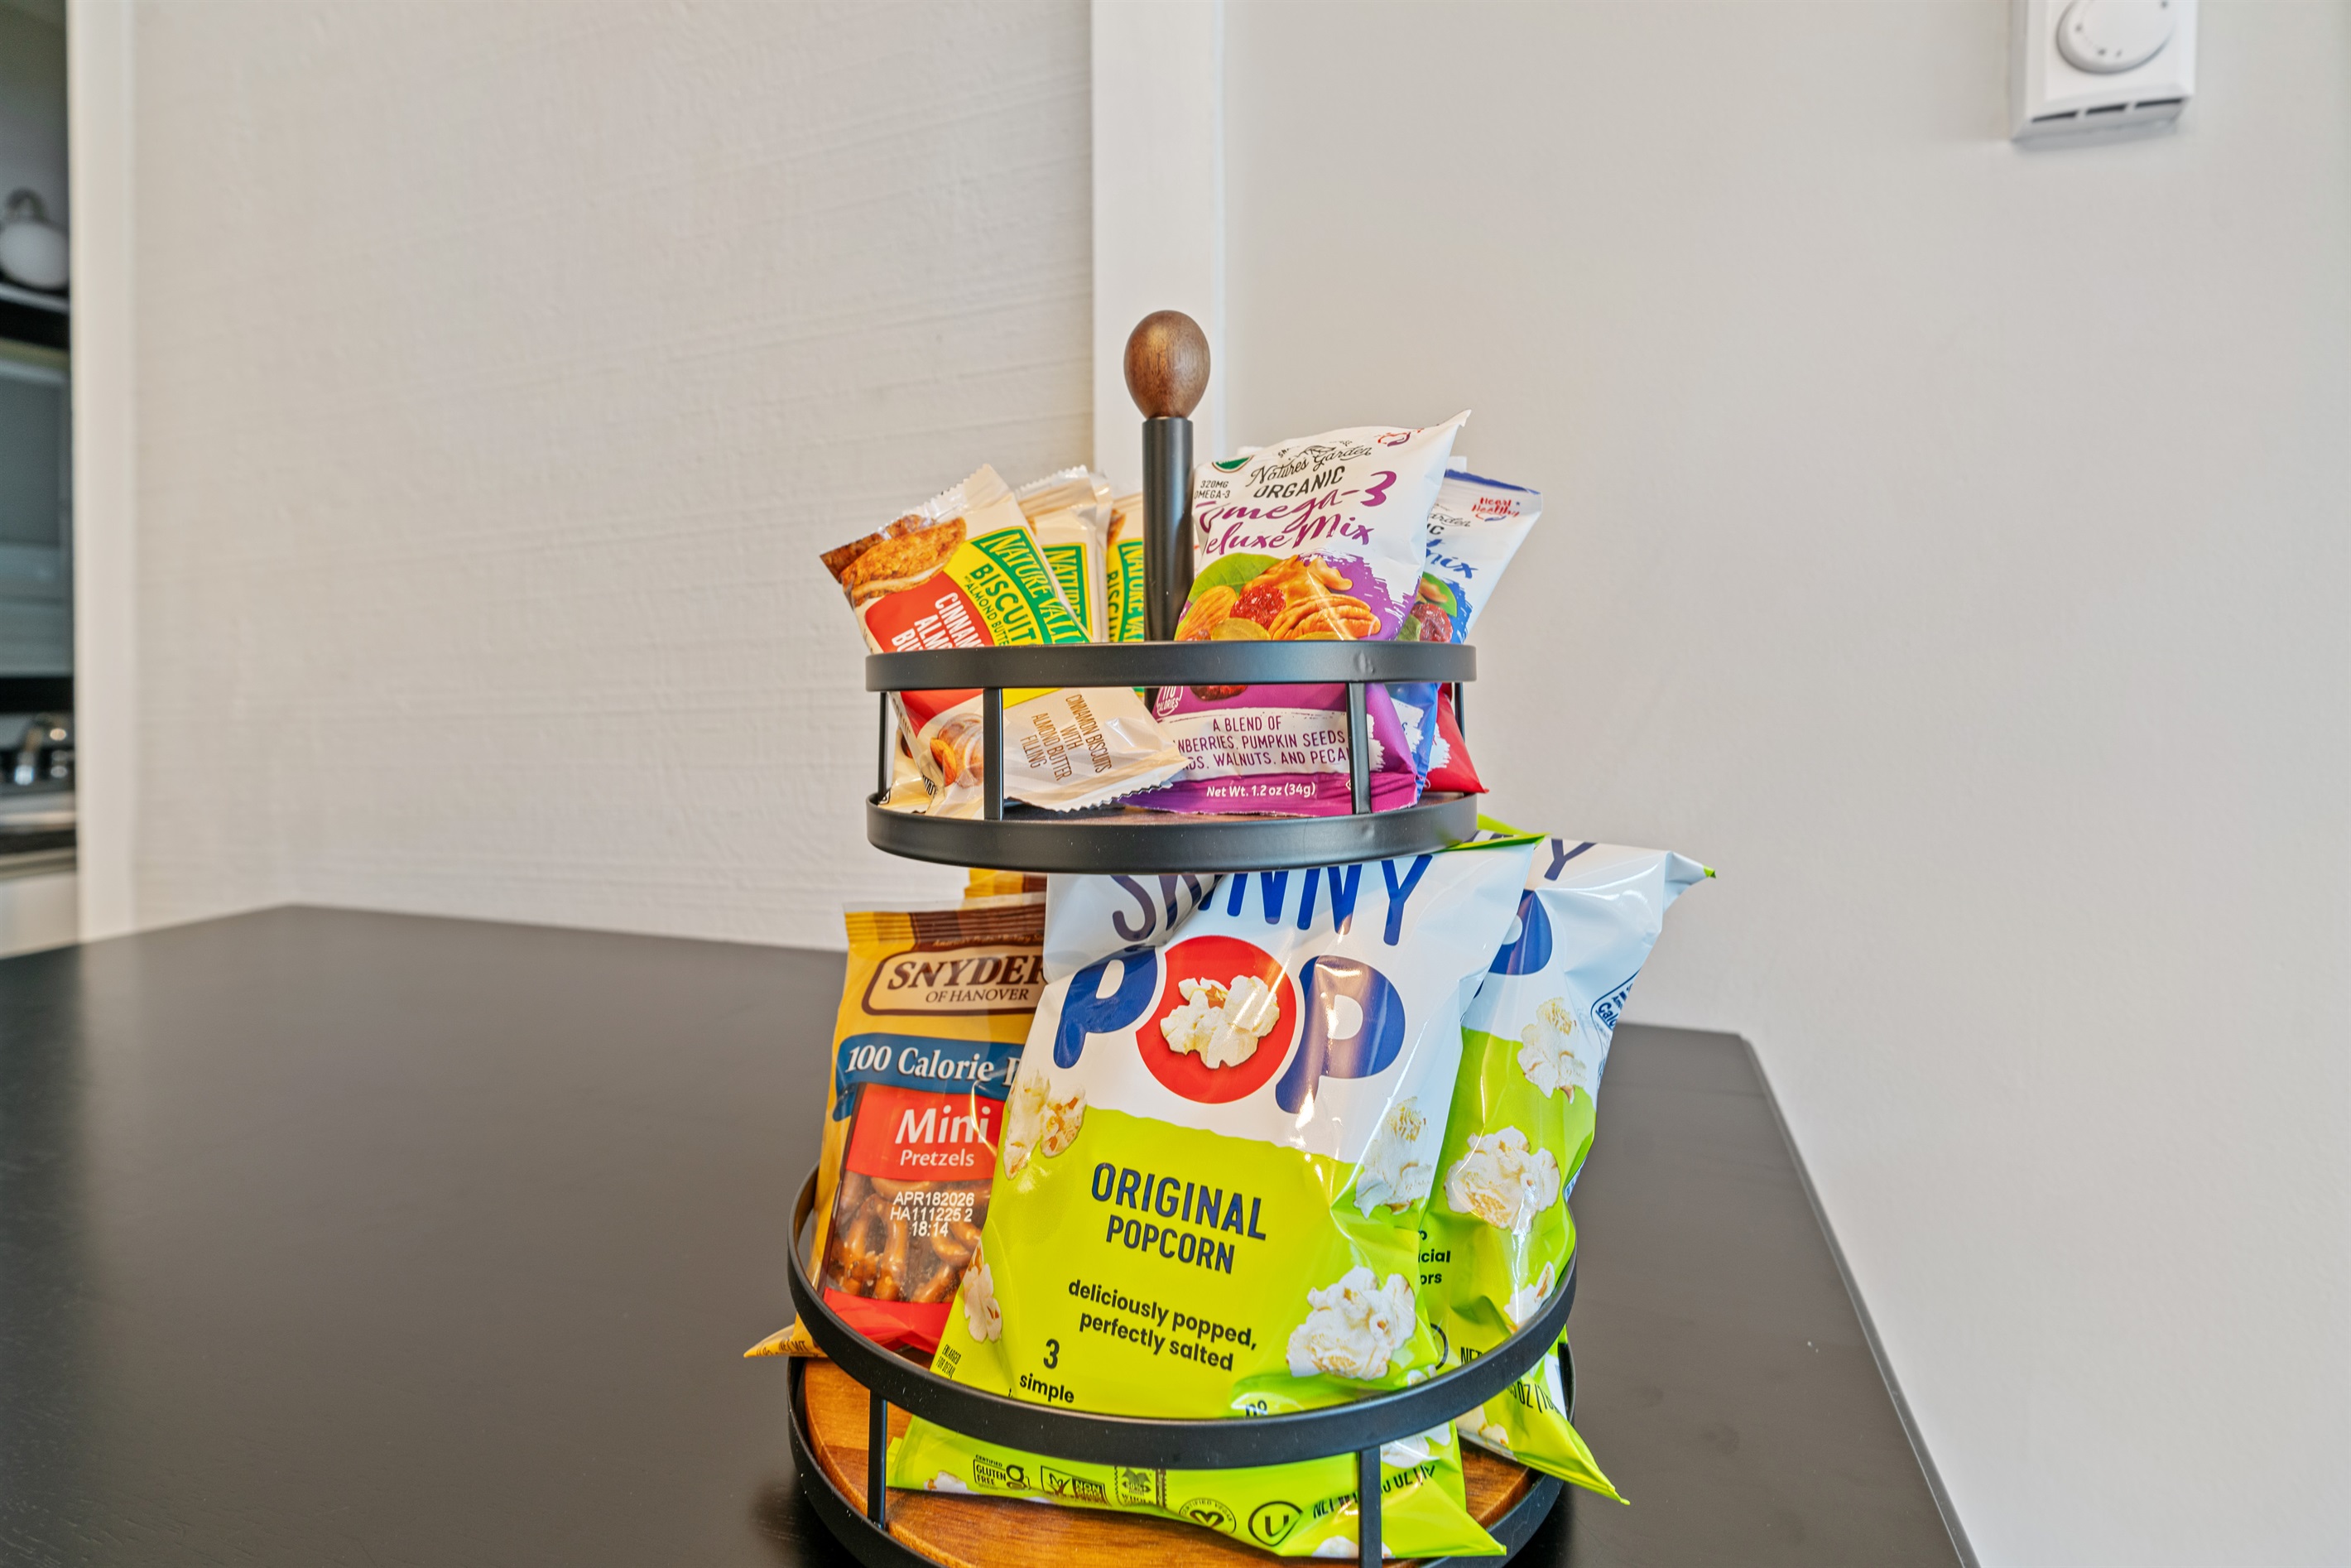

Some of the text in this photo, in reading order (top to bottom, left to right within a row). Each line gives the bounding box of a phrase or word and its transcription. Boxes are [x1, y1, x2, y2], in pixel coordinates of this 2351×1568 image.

[1312, 445, 1373, 473] Garden
[1200, 479, 1230, 490] 320MG
[1252, 465, 1346, 499] ORGANIC
[1478, 497, 1512, 507] Heart
[1205, 513, 1375, 556] eluxe Mix
[979, 533, 1086, 644] NATURE VALL
[964, 583, 998, 621] ALMOND
[991, 620, 1010, 647] BUTTE
[969, 563, 1037, 646] BISCUIT
[914, 613, 954, 651] ALM
[935, 591, 985, 649] CINNAM
[1060, 724, 1084, 751] WITH
[1065, 694, 1113, 774] CINNAMON BISCUITS
[1212, 714, 1282, 732] A BLEND OF
[1019, 734, 1048, 769] FILLING
[1031, 712, 1073, 782] ALMOND BUTTER
[1242, 733, 1298, 750] PUMPKIN
[1280, 750, 1306, 765] AND
[1310, 746, 1350, 764] PECA
[1206, 782, 1317, 800] Net Wt. 1.2 oz (34g)
[925, 988, 1030, 1003] OF HANOVER
[844, 1044, 893, 1075] 100
[897, 1046, 995, 1083] Calorie
[895, 1104, 992, 1145] Mini
[899, 1148, 975, 1167] Pretzels
[892, 1190, 975, 1207] APR182026
[1090, 1162, 1267, 1241] ORIGINAL
[911, 1219, 950, 1238] 18:14
[963, 1207, 974, 1223] 2
[1105, 1214, 1235, 1275] POPCORN
[1068, 1279, 1257, 1351] deliciously popped,
[941, 1344, 962, 1365] ENLARGED
[1043, 1338, 1060, 1370] 3
[1078, 1311, 1234, 1372] perfectly salted
[1019, 1373, 1075, 1404] simple
[975, 1454, 1003, 1468] CERTIFIED
[975, 1464, 1007, 1482] GLUTEN
[976, 1474, 995, 1486] FREE
[1075, 1479, 1101, 1491] NON
